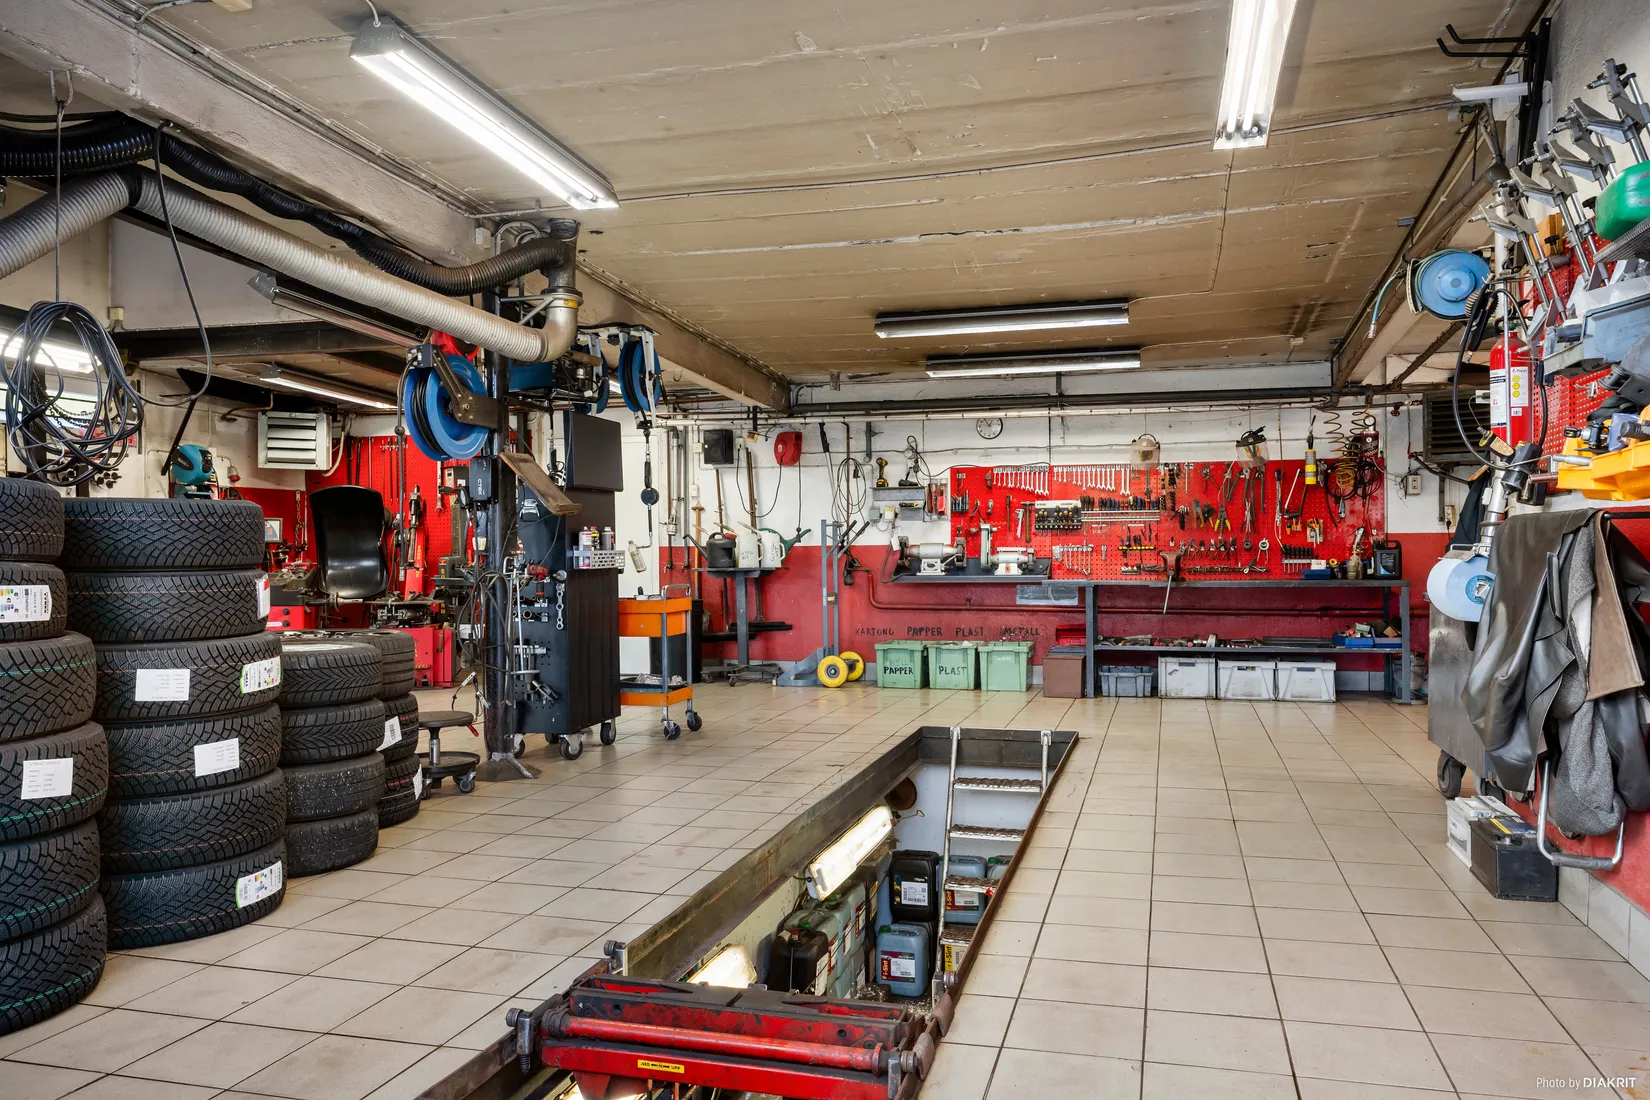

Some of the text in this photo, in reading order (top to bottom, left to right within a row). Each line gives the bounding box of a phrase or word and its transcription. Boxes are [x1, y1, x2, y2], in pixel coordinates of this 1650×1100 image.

[855, 627, 895, 636] KARTONG
[907, 626, 943, 636] PAPPER
[955, 627, 985, 637] PLAST
[1003, 627, 1040, 636] METALL
[883, 666, 914, 675] PAPPER
[938, 666, 967, 675] PLAST
